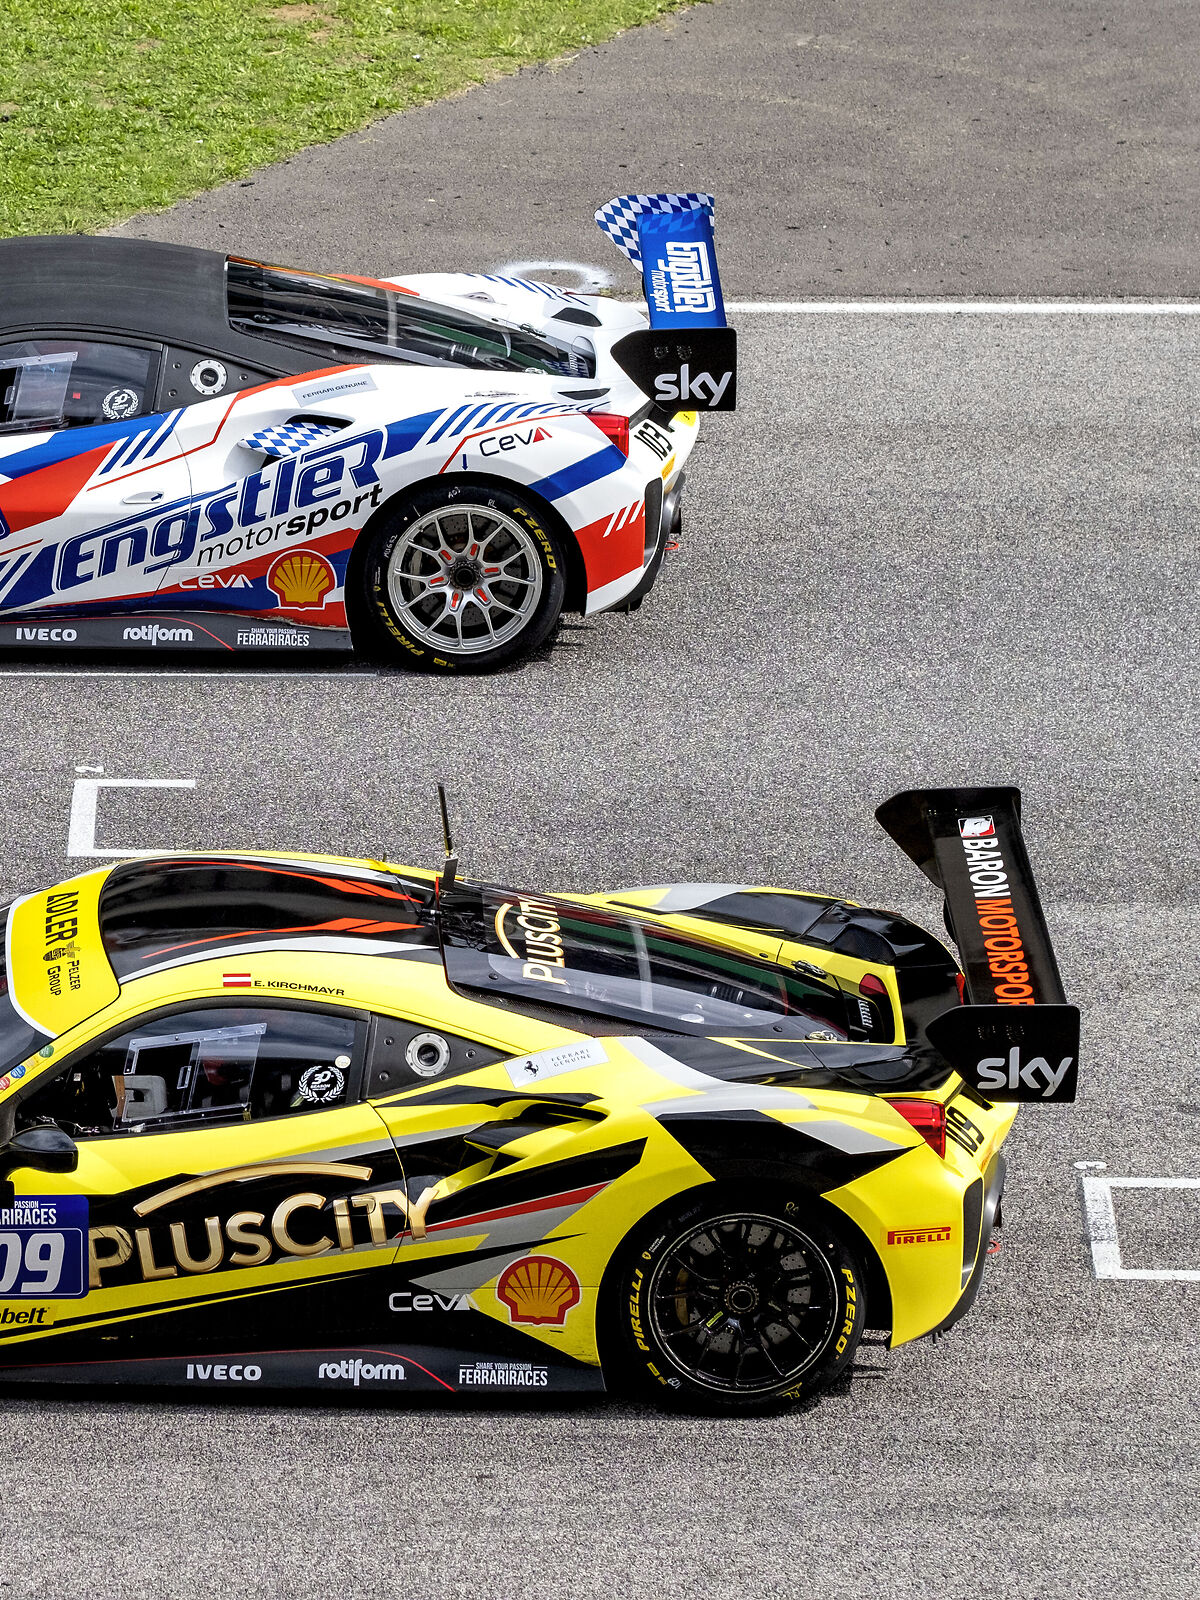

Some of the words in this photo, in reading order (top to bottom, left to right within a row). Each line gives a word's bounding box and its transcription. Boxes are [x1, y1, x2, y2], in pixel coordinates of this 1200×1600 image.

[651, 269, 674, 313] motorsport
[302, 387, 334, 399] FERRARI
[335, 380, 369, 391] GENUINE
[654, 363, 733, 407] sky
[638, 421, 673, 461] 103
[197, 483, 384, 567] motorsport
[15, 627, 78, 642] IVECO
[123, 624, 194, 646] rotiform
[237, 633, 309, 647] FERRARIRACES
[376, 601, 425, 656] PIRELLI
[962, 837, 1012, 898] BARON
[45, 891, 79, 946] ADLER
[974, 898, 1035, 1006] MOTORSPOR
[47, 965, 62, 996] GROUP
[67, 959, 81, 991] PELZER
[254, 980, 266, 988] E.
[267, 980, 345, 996] KIRCHMAYR
[551, 1048, 590, 1062] FERRARI
[553, 1054, 591, 1068] GENUINE
[976, 1046, 1074, 1097] sky
[14, 1200, 39, 1209] PASSION
[88, 1186, 440, 1290] PLUSCITY
[887, 1226, 952, 1245] PIRELLI
[629, 1268, 650, 1351] PIRELLI
[186, 1363, 262, 1381] IVECO
[318, 1357, 407, 1387] rotiform
[459, 1369, 548, 1386] FERRARIRACES
[475, 1362, 493, 1370] SHARE
[494, 1362, 509, 1370] YOUR
[509, 1363, 532, 1371] PASSION
